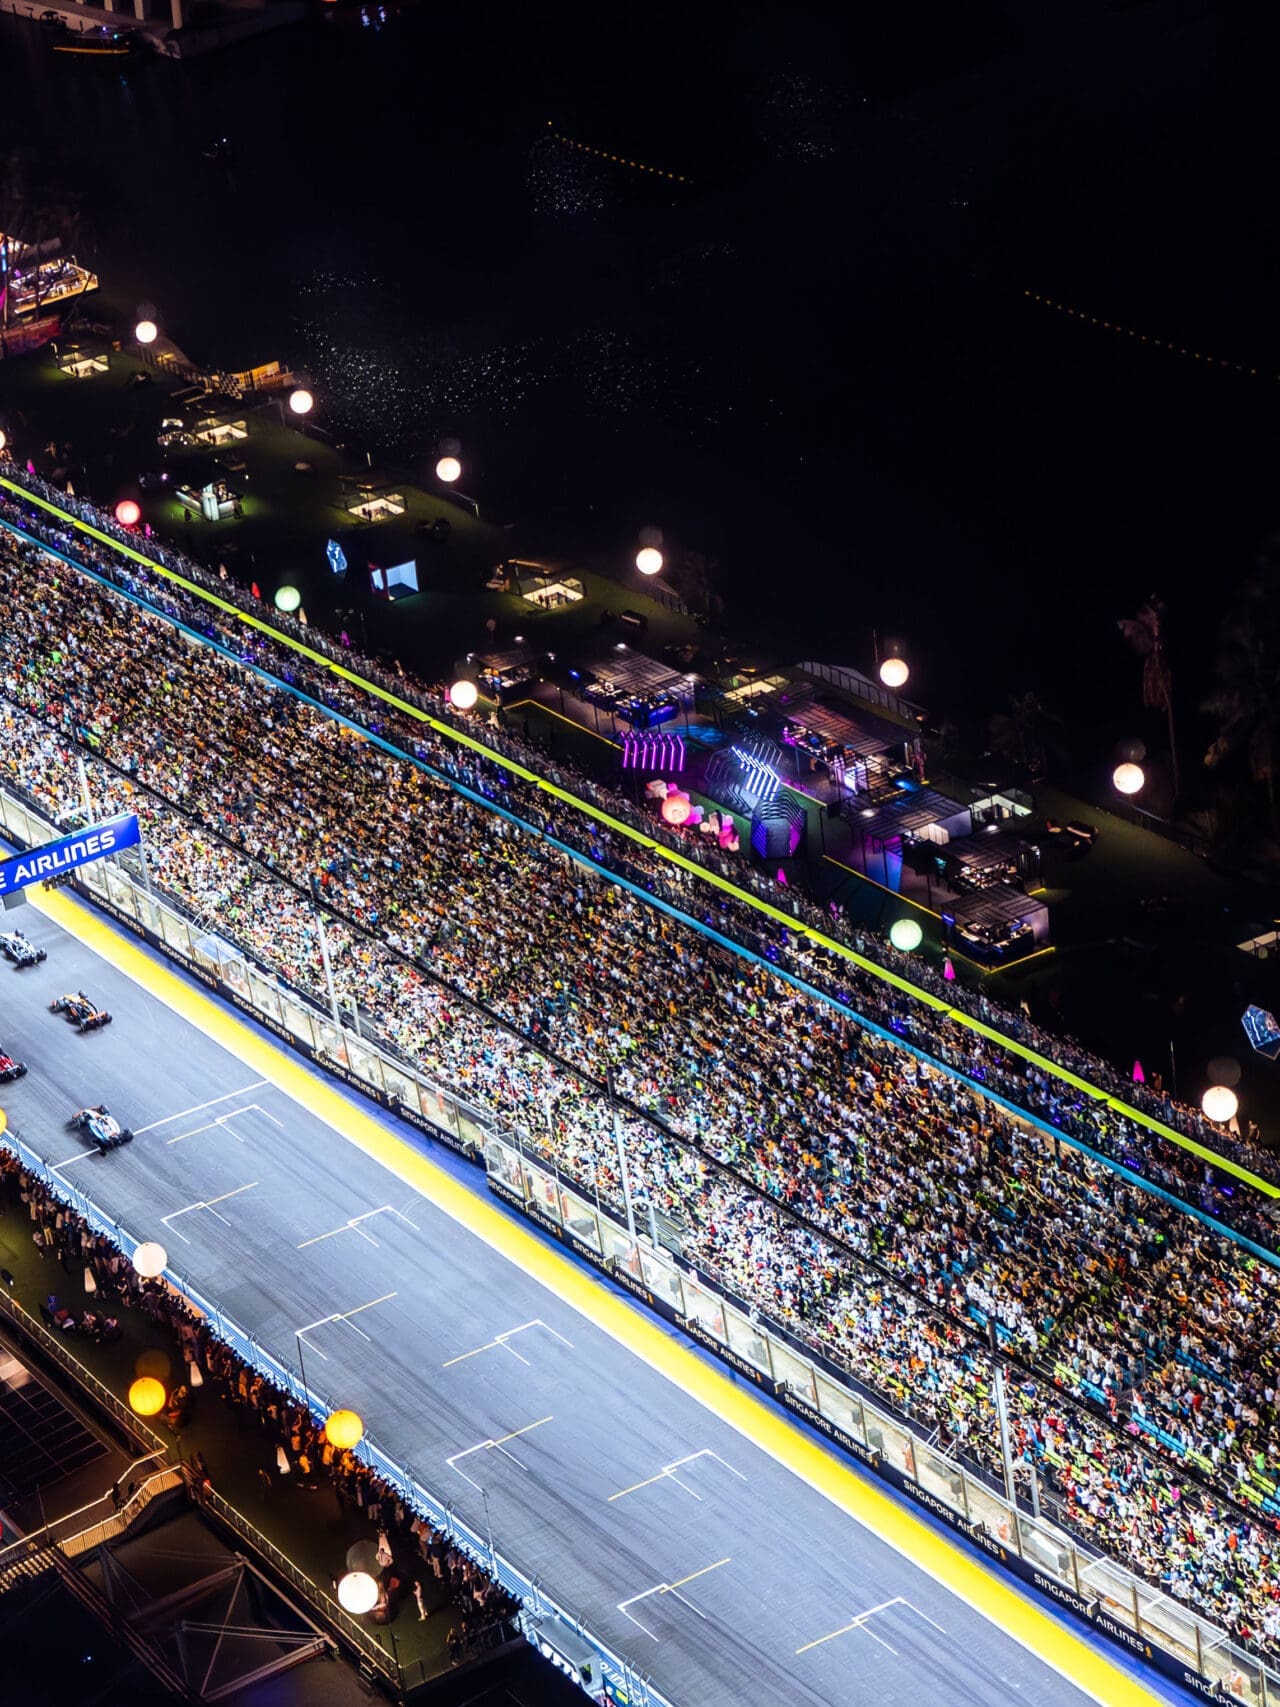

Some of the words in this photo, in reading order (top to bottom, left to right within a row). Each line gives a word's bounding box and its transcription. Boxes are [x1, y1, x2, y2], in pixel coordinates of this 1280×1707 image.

[14, 830, 116, 883] AIRLINES
[903, 1480, 954, 1521] SINGAPORE
[1096, 1615, 1144, 1652] AIRLINES
